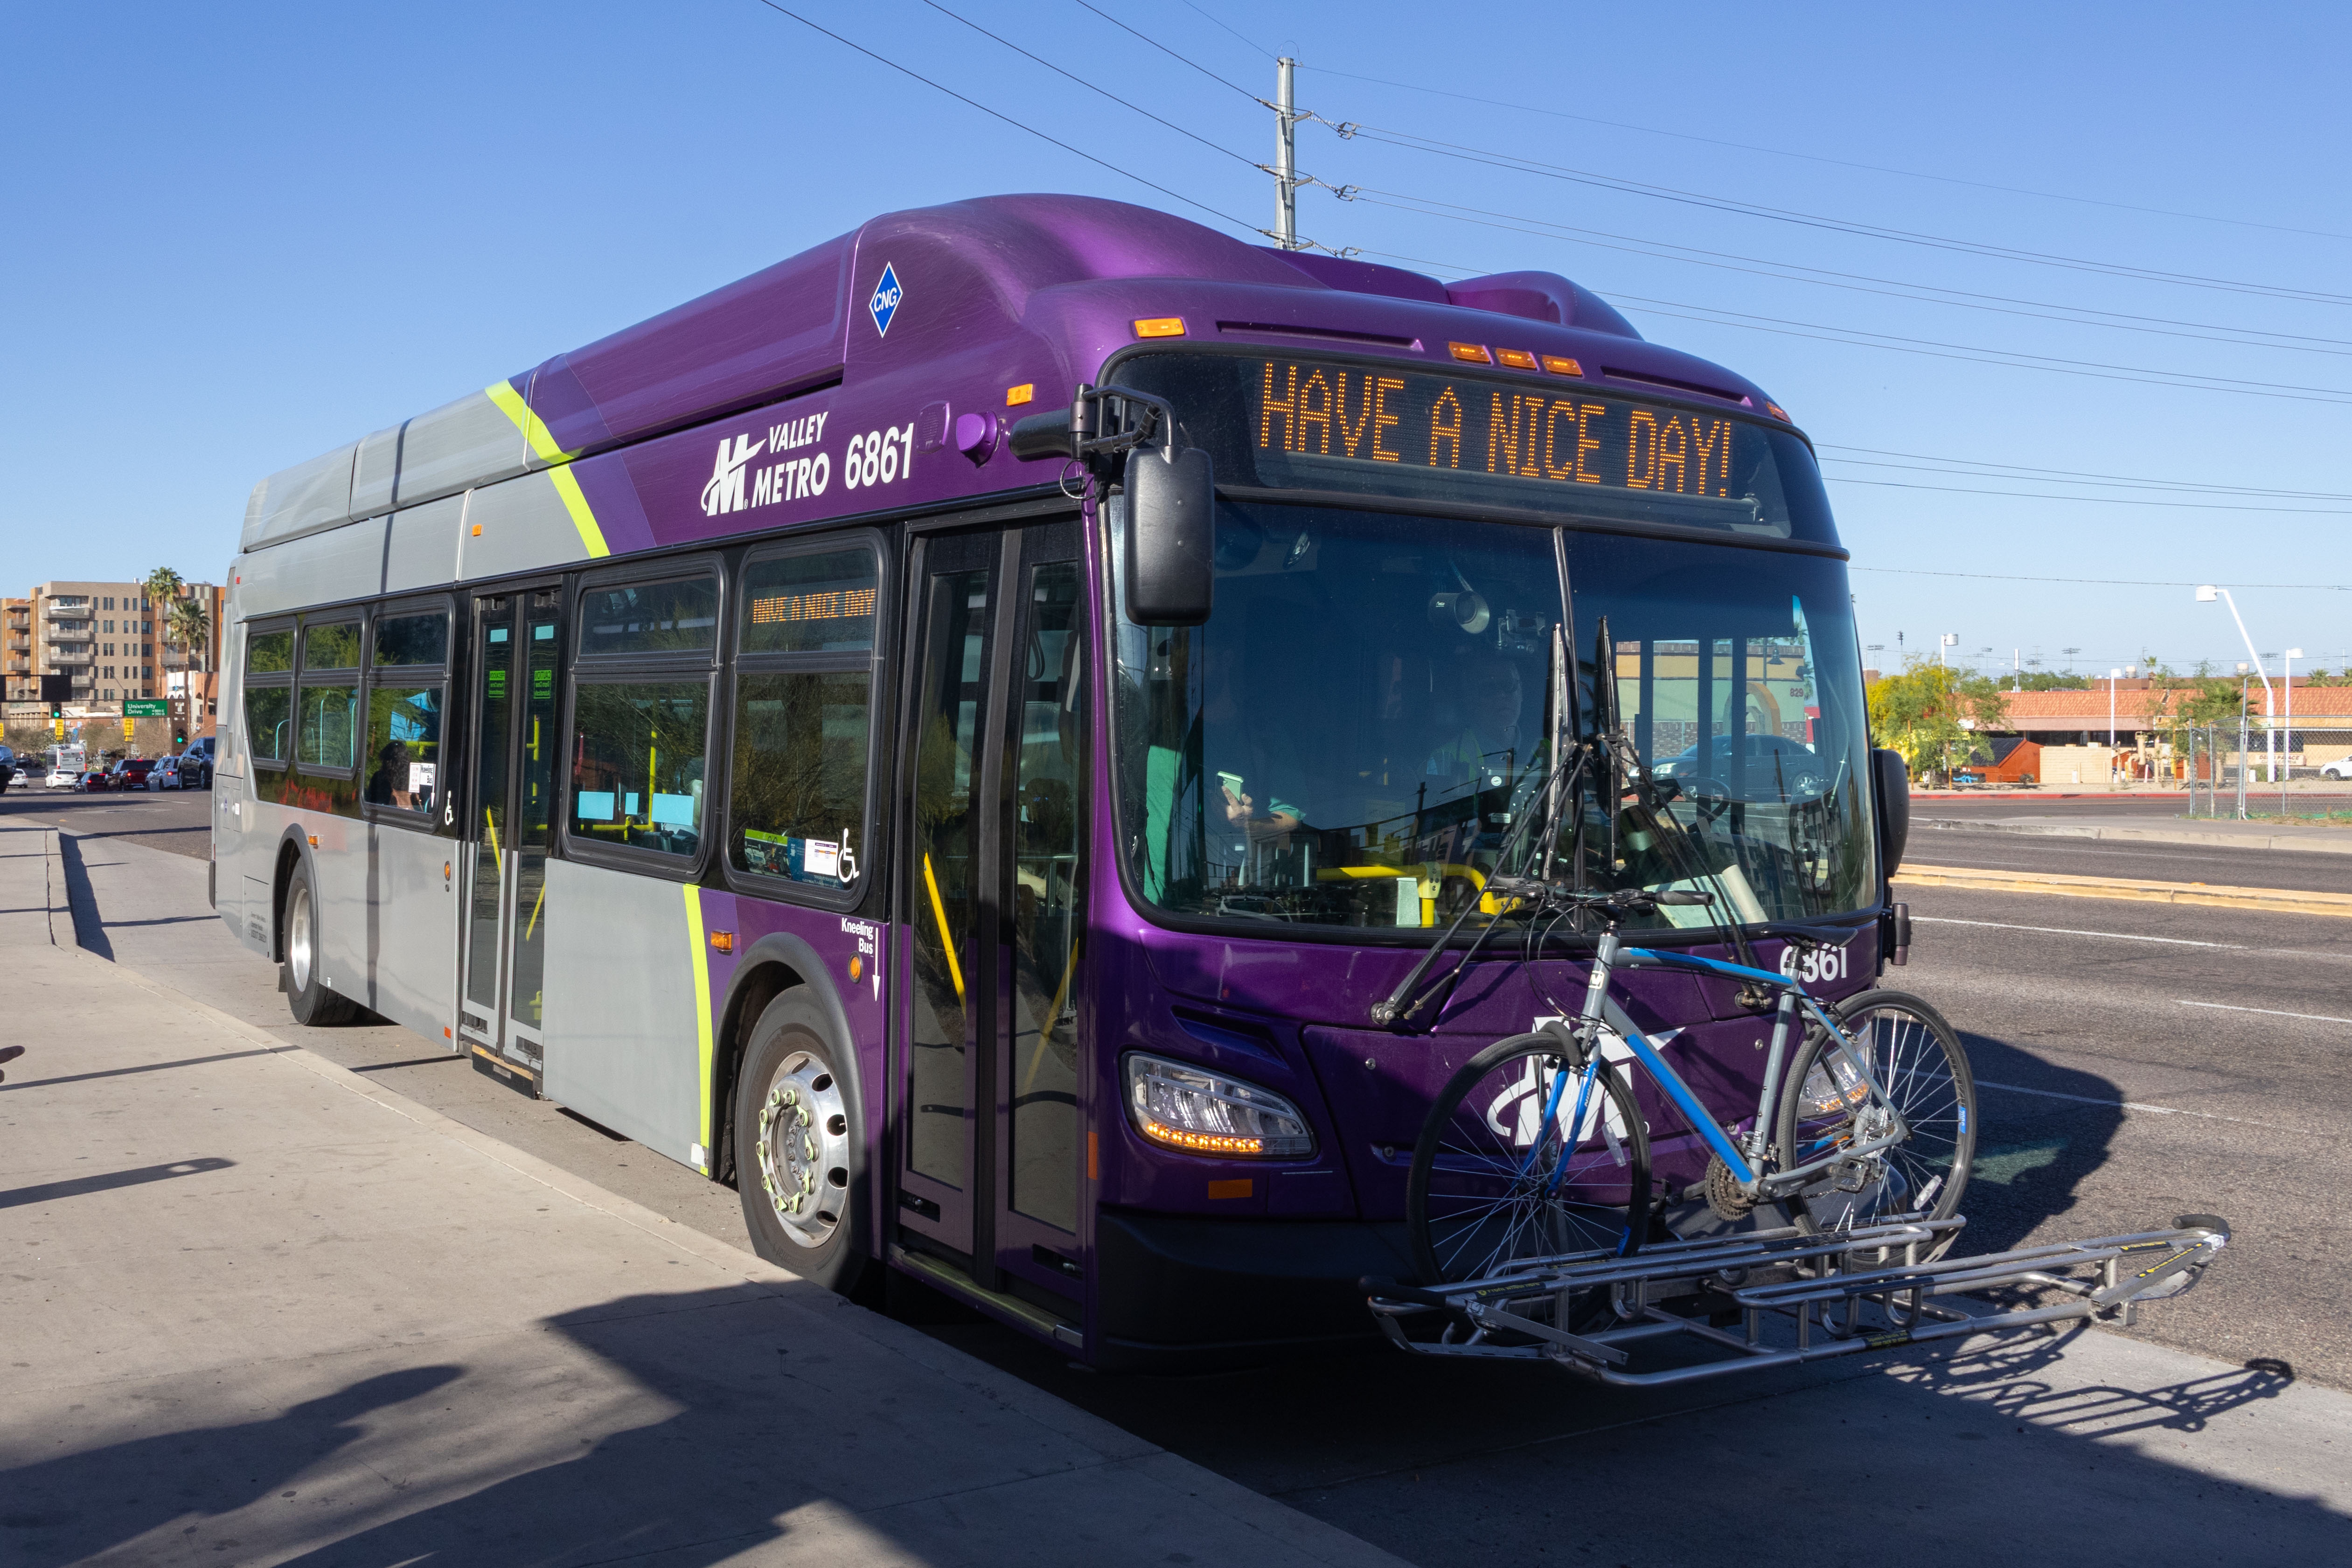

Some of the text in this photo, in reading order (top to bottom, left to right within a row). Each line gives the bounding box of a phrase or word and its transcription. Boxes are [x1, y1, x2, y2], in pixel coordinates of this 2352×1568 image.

[874, 287, 897, 312] CNG
[769, 411, 828, 453] VALLEY
[1260, 362, 1731, 498] HAVE A NICE DAY!
[845, 422, 914, 490] 6861
[751, 453, 830, 508] METRO
[752, 597, 787, 623] HAVE
[791, 596, 800, 620] A
[805, 592, 840, 620] NICE
[1790, 688, 1803, 697] 829
[841, 917, 874, 941] Kneeling
[858, 937, 873, 955] Bus
